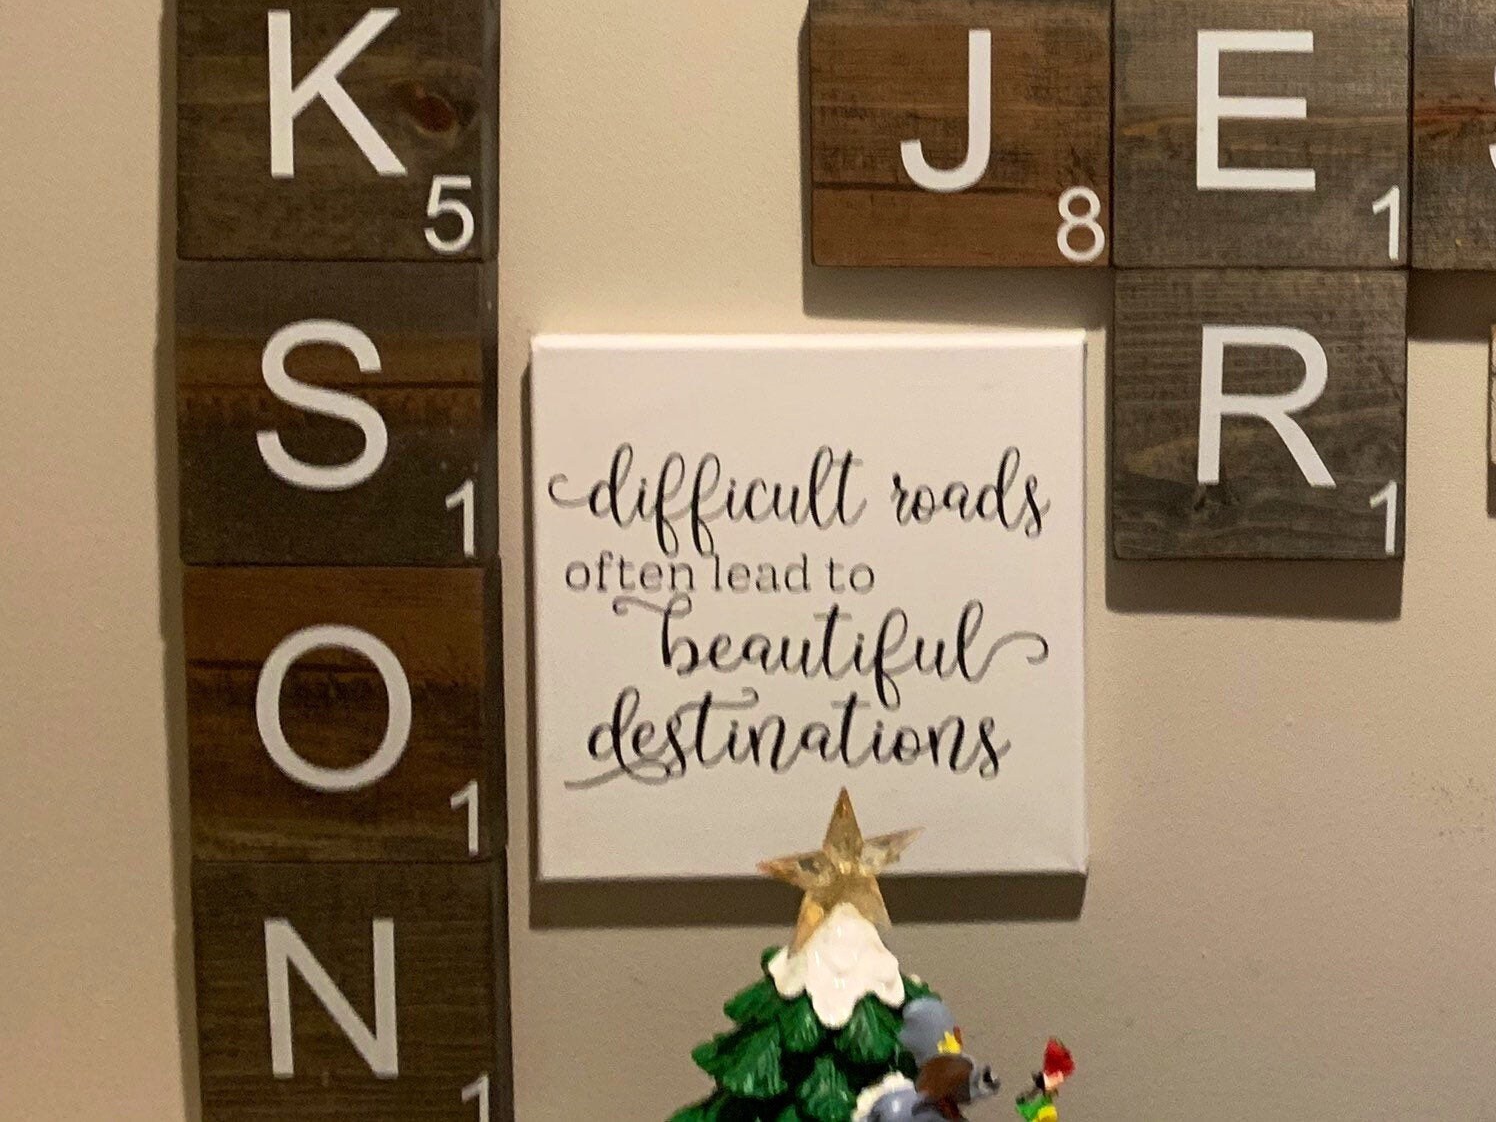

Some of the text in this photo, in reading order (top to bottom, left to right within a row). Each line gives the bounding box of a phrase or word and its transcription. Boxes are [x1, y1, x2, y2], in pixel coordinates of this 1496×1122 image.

[424, 175, 475, 253] 5
[1055, 185, 1106, 262] 8
[1371, 185, 1401, 261] 1
[445, 480, 475, 555] 1
[548, 442, 1051, 557] difficult roads
[1369, 480, 1398, 554] 1
[565, 550, 876, 594] often lead to
[612, 591, 1050, 710] beautiful
[564, 685, 1012, 790] destinations
[449, 782, 479, 854] 1
